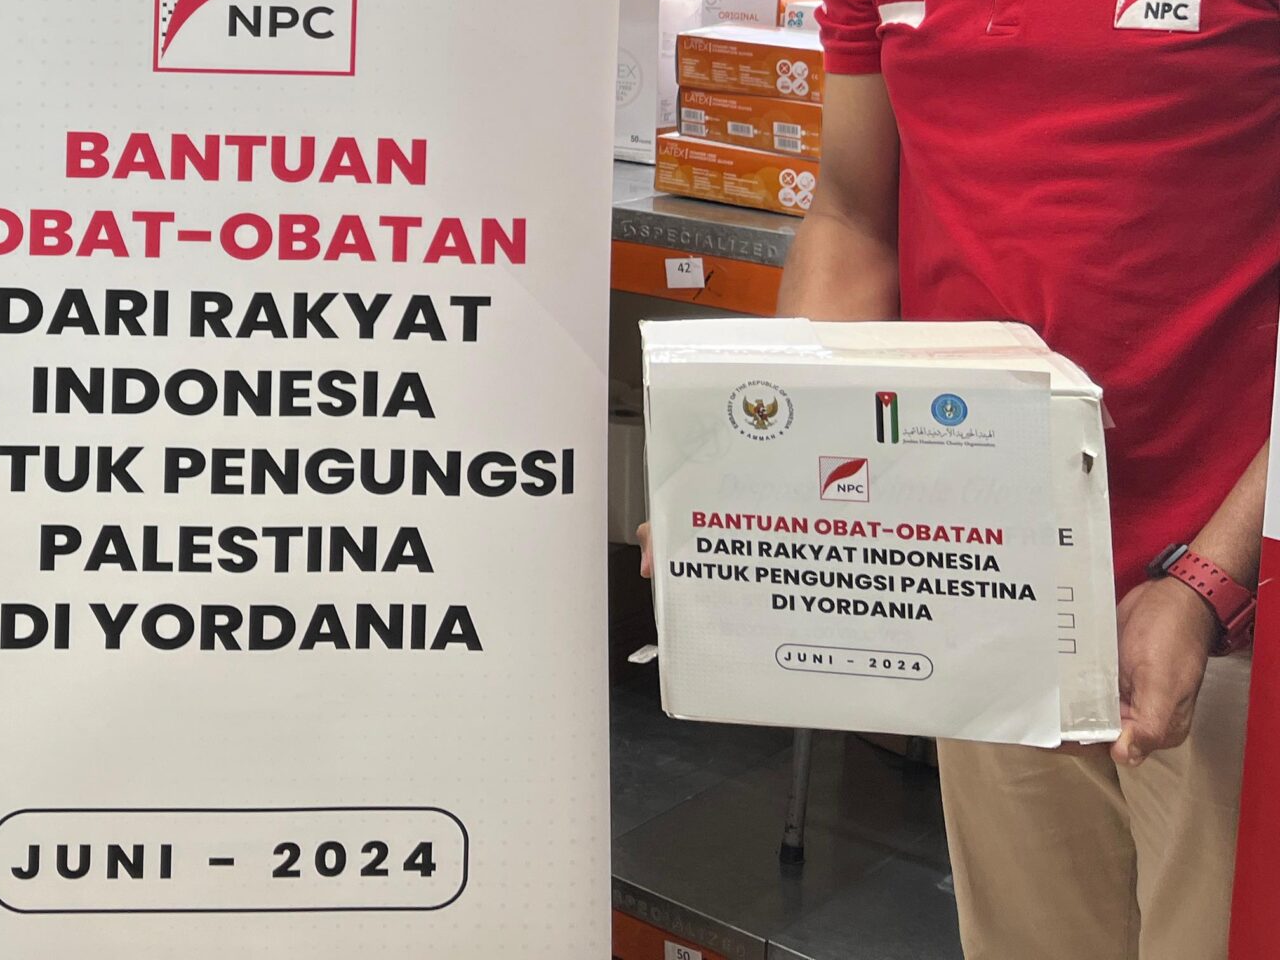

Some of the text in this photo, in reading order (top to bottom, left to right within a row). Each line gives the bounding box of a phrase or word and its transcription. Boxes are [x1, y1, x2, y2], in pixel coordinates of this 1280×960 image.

[227, 4, 335, 40] NPC
[718, 10, 760, 22] ORIGINAL
[1144, 1, 1189, 21] NPC
[684, 39, 709, 51] LATEX
[684, 92, 710, 105] LATEX
[631, 135, 639, 143] 50
[659, 144, 685, 158] LATEX
[65, 131, 428, 186] BANTUAN
[639, 225, 780, 259] SPECIALIZED
[677, 261, 691, 274] 42
[189, 290, 492, 343] RAKYAT
[31, 366, 437, 419] INDONESIA
[162, 447, 576, 498] PENGUNGSI
[836, 483, 864, 494] NPC
[691, 510, 1004, 546] BANTUAN OBAT-OBATAN
[38, 523, 435, 574] PALESTINA
[696, 537, 1001, 573] DARI RAKYAT INDONESIA
[669, 560, 1037, 601] UNTUK PENGUNGSI PALESTINA
[771, 593, 933, 621] DI YORDANIA
[0, 602, 484, 651] DI YORDANIA
[783, 652, 834, 665] JUNI
[868, 657, 922, 673] 2024
[10, 843, 174, 881] JUNI
[271, 840, 439, 879] 2024
[676, 948, 690, 960] 50
